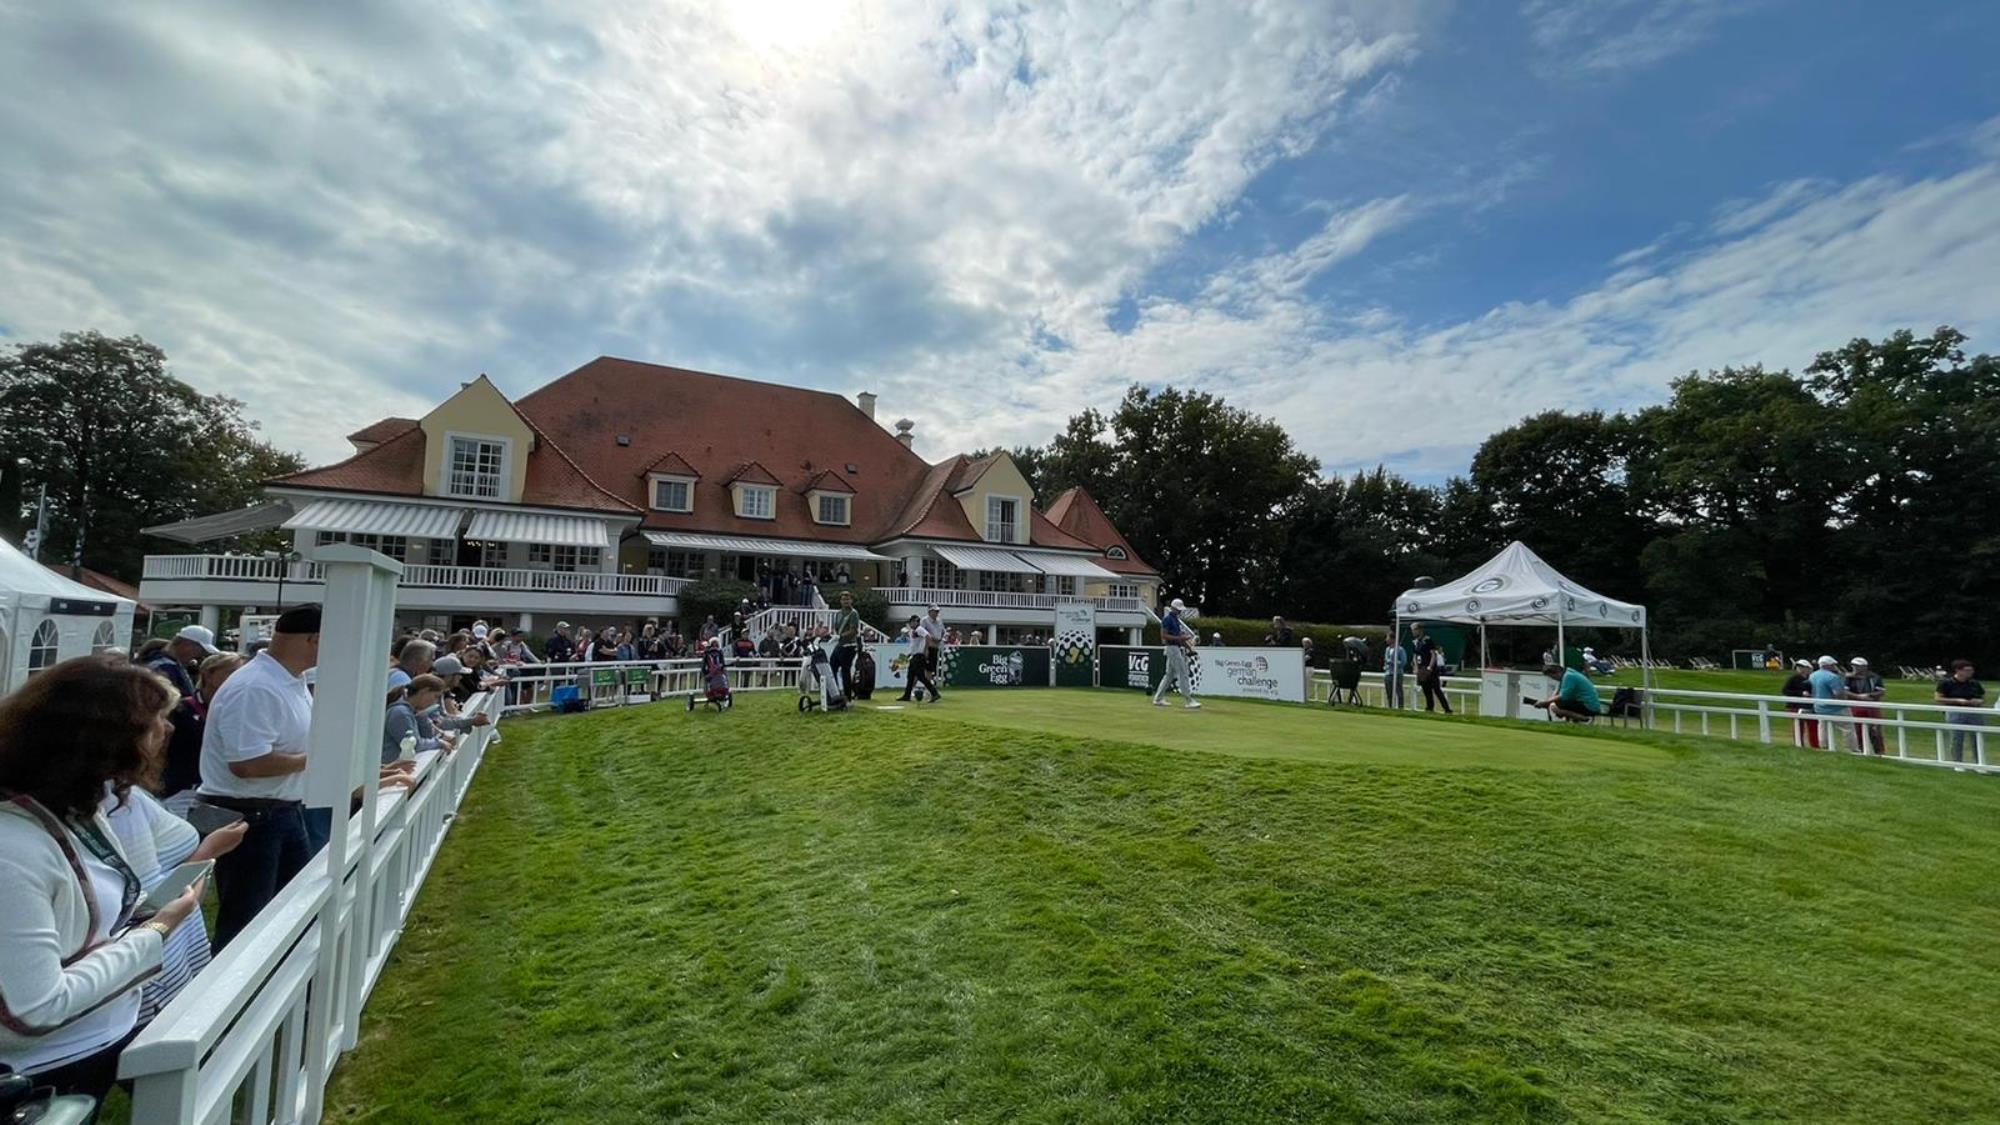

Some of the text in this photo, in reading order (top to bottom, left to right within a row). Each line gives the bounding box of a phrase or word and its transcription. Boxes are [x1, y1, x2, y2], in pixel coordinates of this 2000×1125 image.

[993, 654, 1008, 666] Big
[979, 663, 1007, 674] Green
[1227, 667, 1257, 678] german
[990, 672, 1008, 685] Egg
[1237, 678, 1278, 689] challenge
